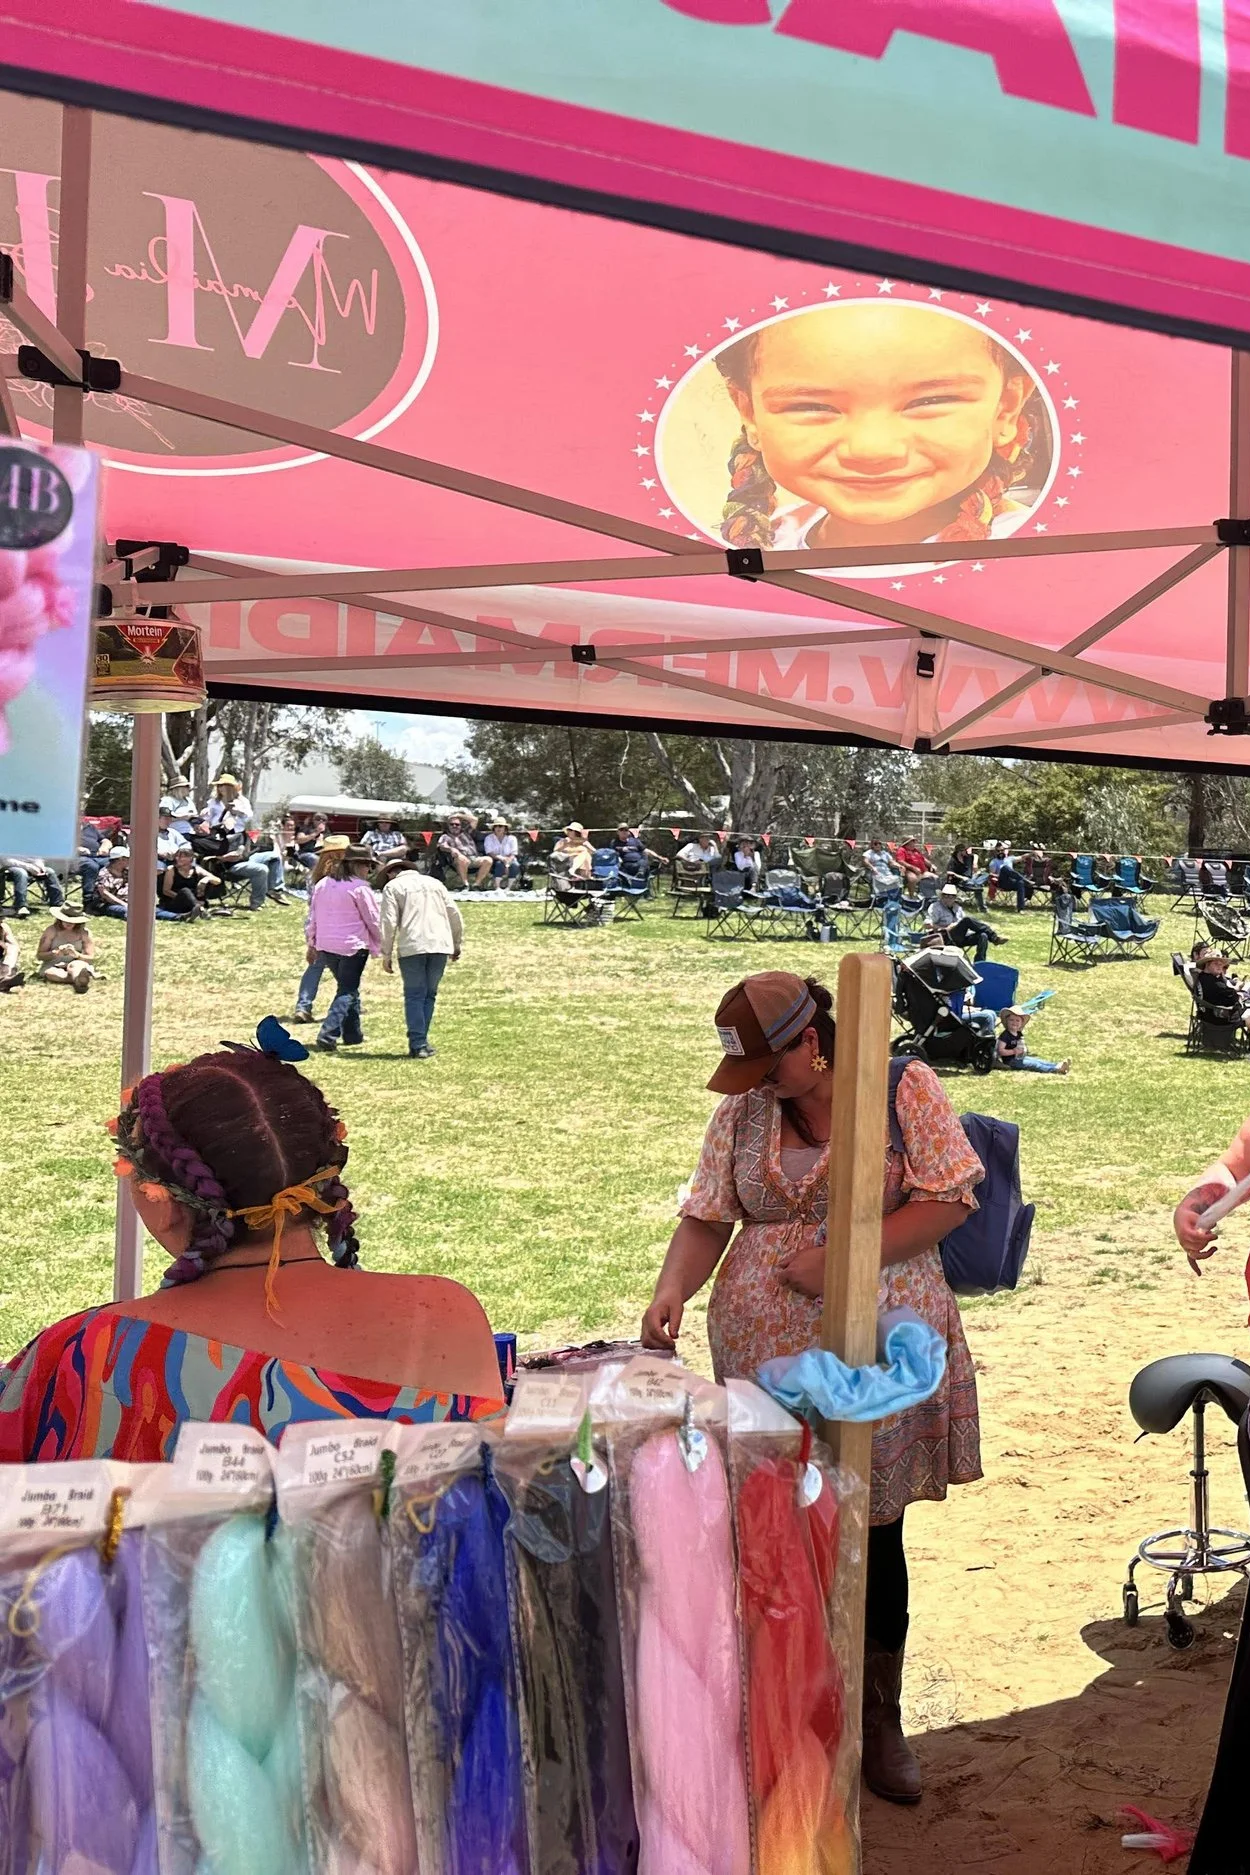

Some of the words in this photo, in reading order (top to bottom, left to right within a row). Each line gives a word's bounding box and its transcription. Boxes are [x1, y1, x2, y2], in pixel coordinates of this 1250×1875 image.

[127, 625, 163, 637] Mortein
[200, 1443, 232, 1454] Jumbo
[310, 1441, 341, 1456] Jumbo
[353, 1437, 379, 1449] Braid
[21, 1488, 57, 1502] Jumbo
